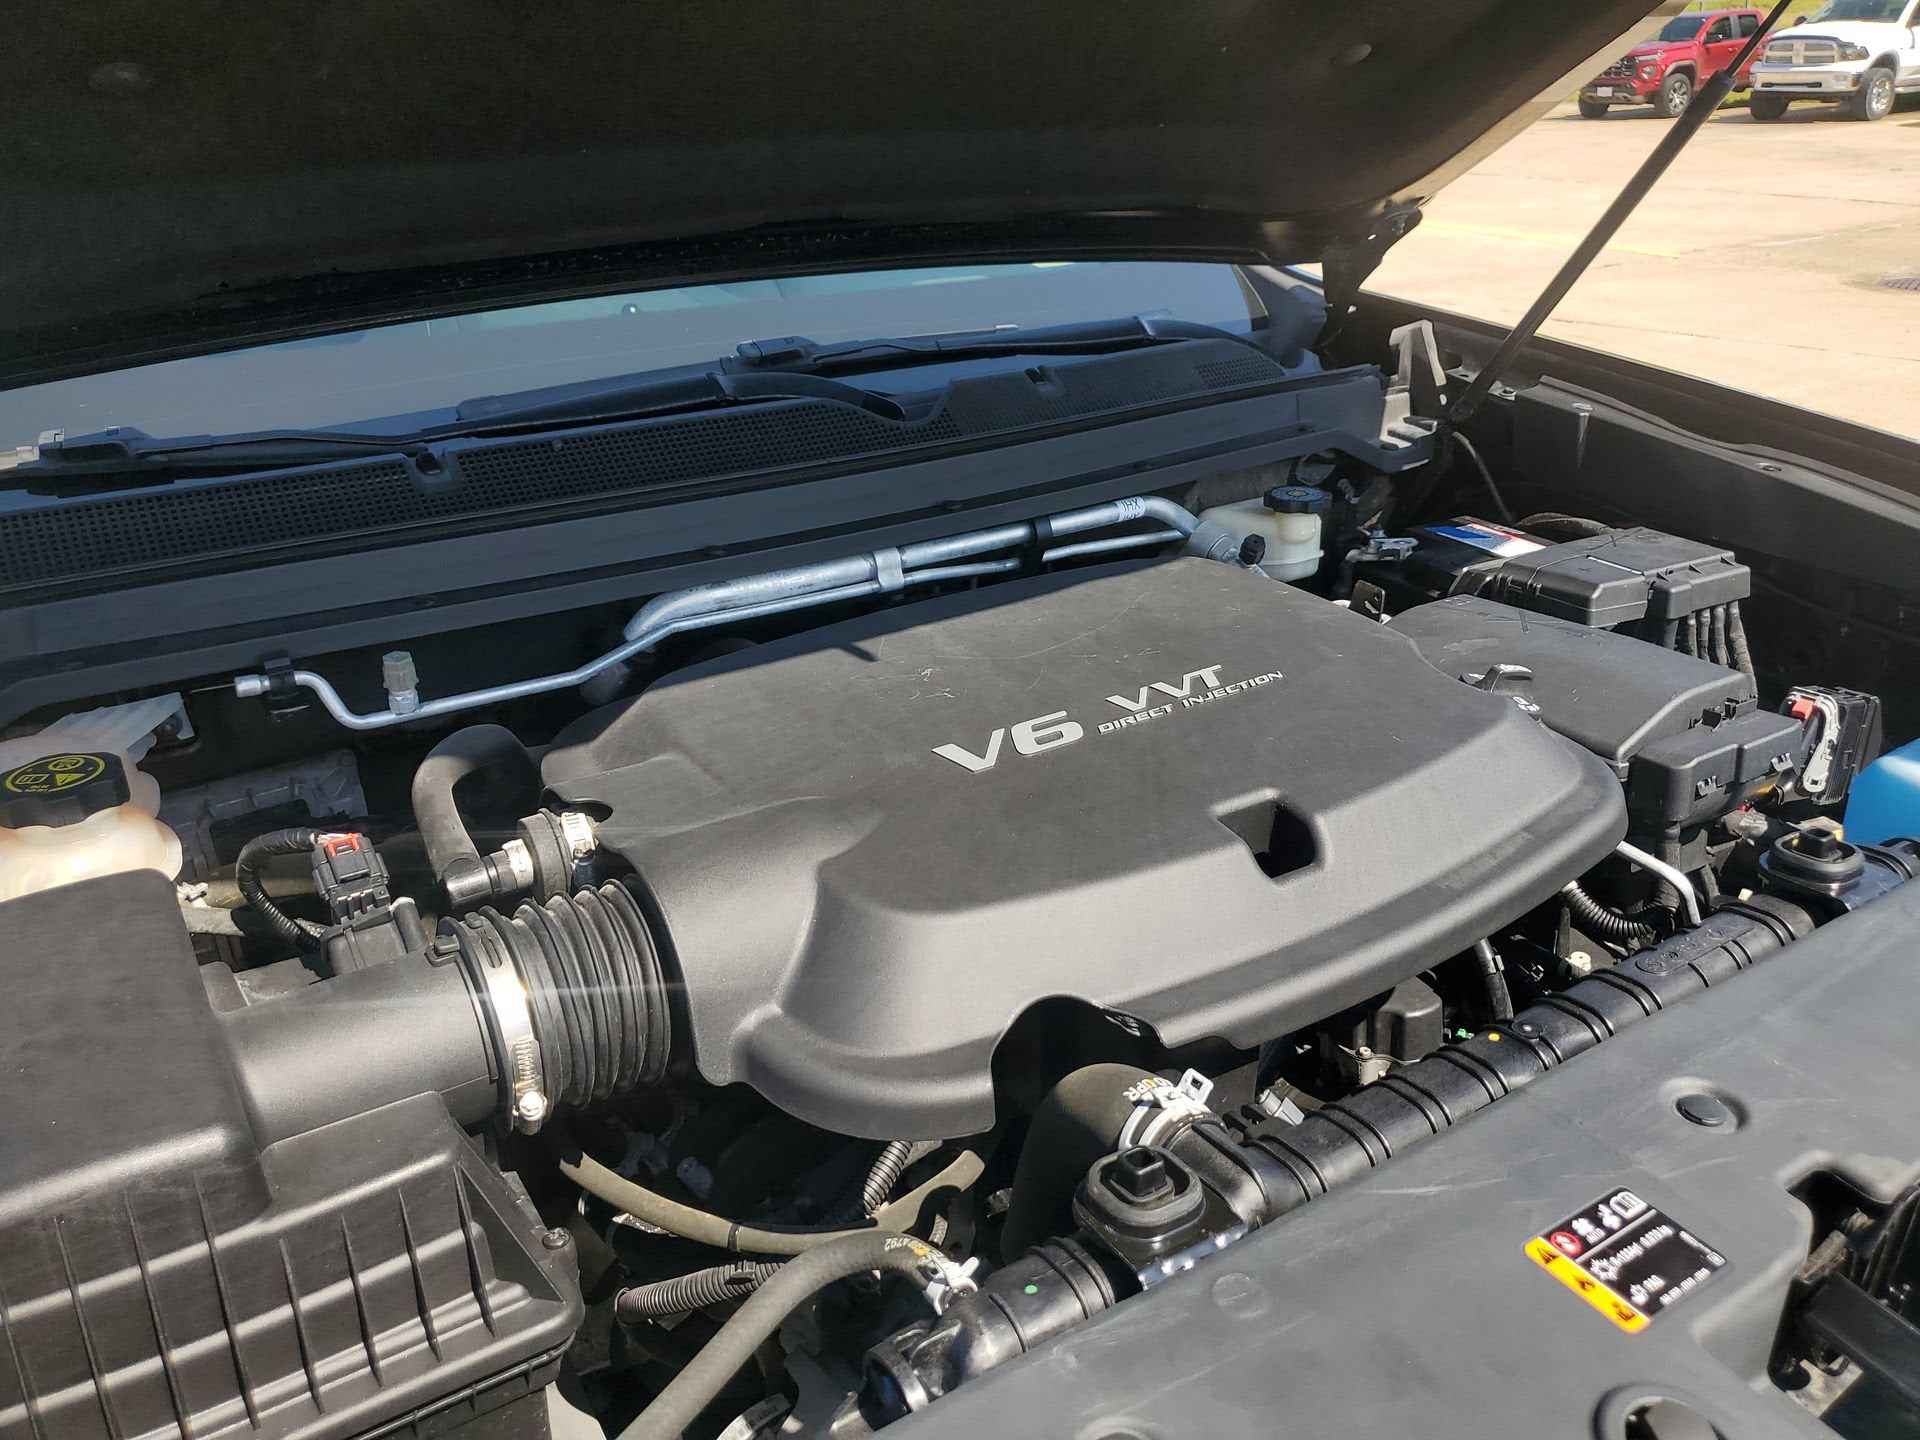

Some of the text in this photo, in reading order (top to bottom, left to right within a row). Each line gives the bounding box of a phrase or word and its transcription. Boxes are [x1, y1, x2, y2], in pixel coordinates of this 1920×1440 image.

[1097, 670, 1284, 735] DIRECT INJECTION
[1105, 664, 1221, 712] VVT
[932, 710, 1084, 773] V6
